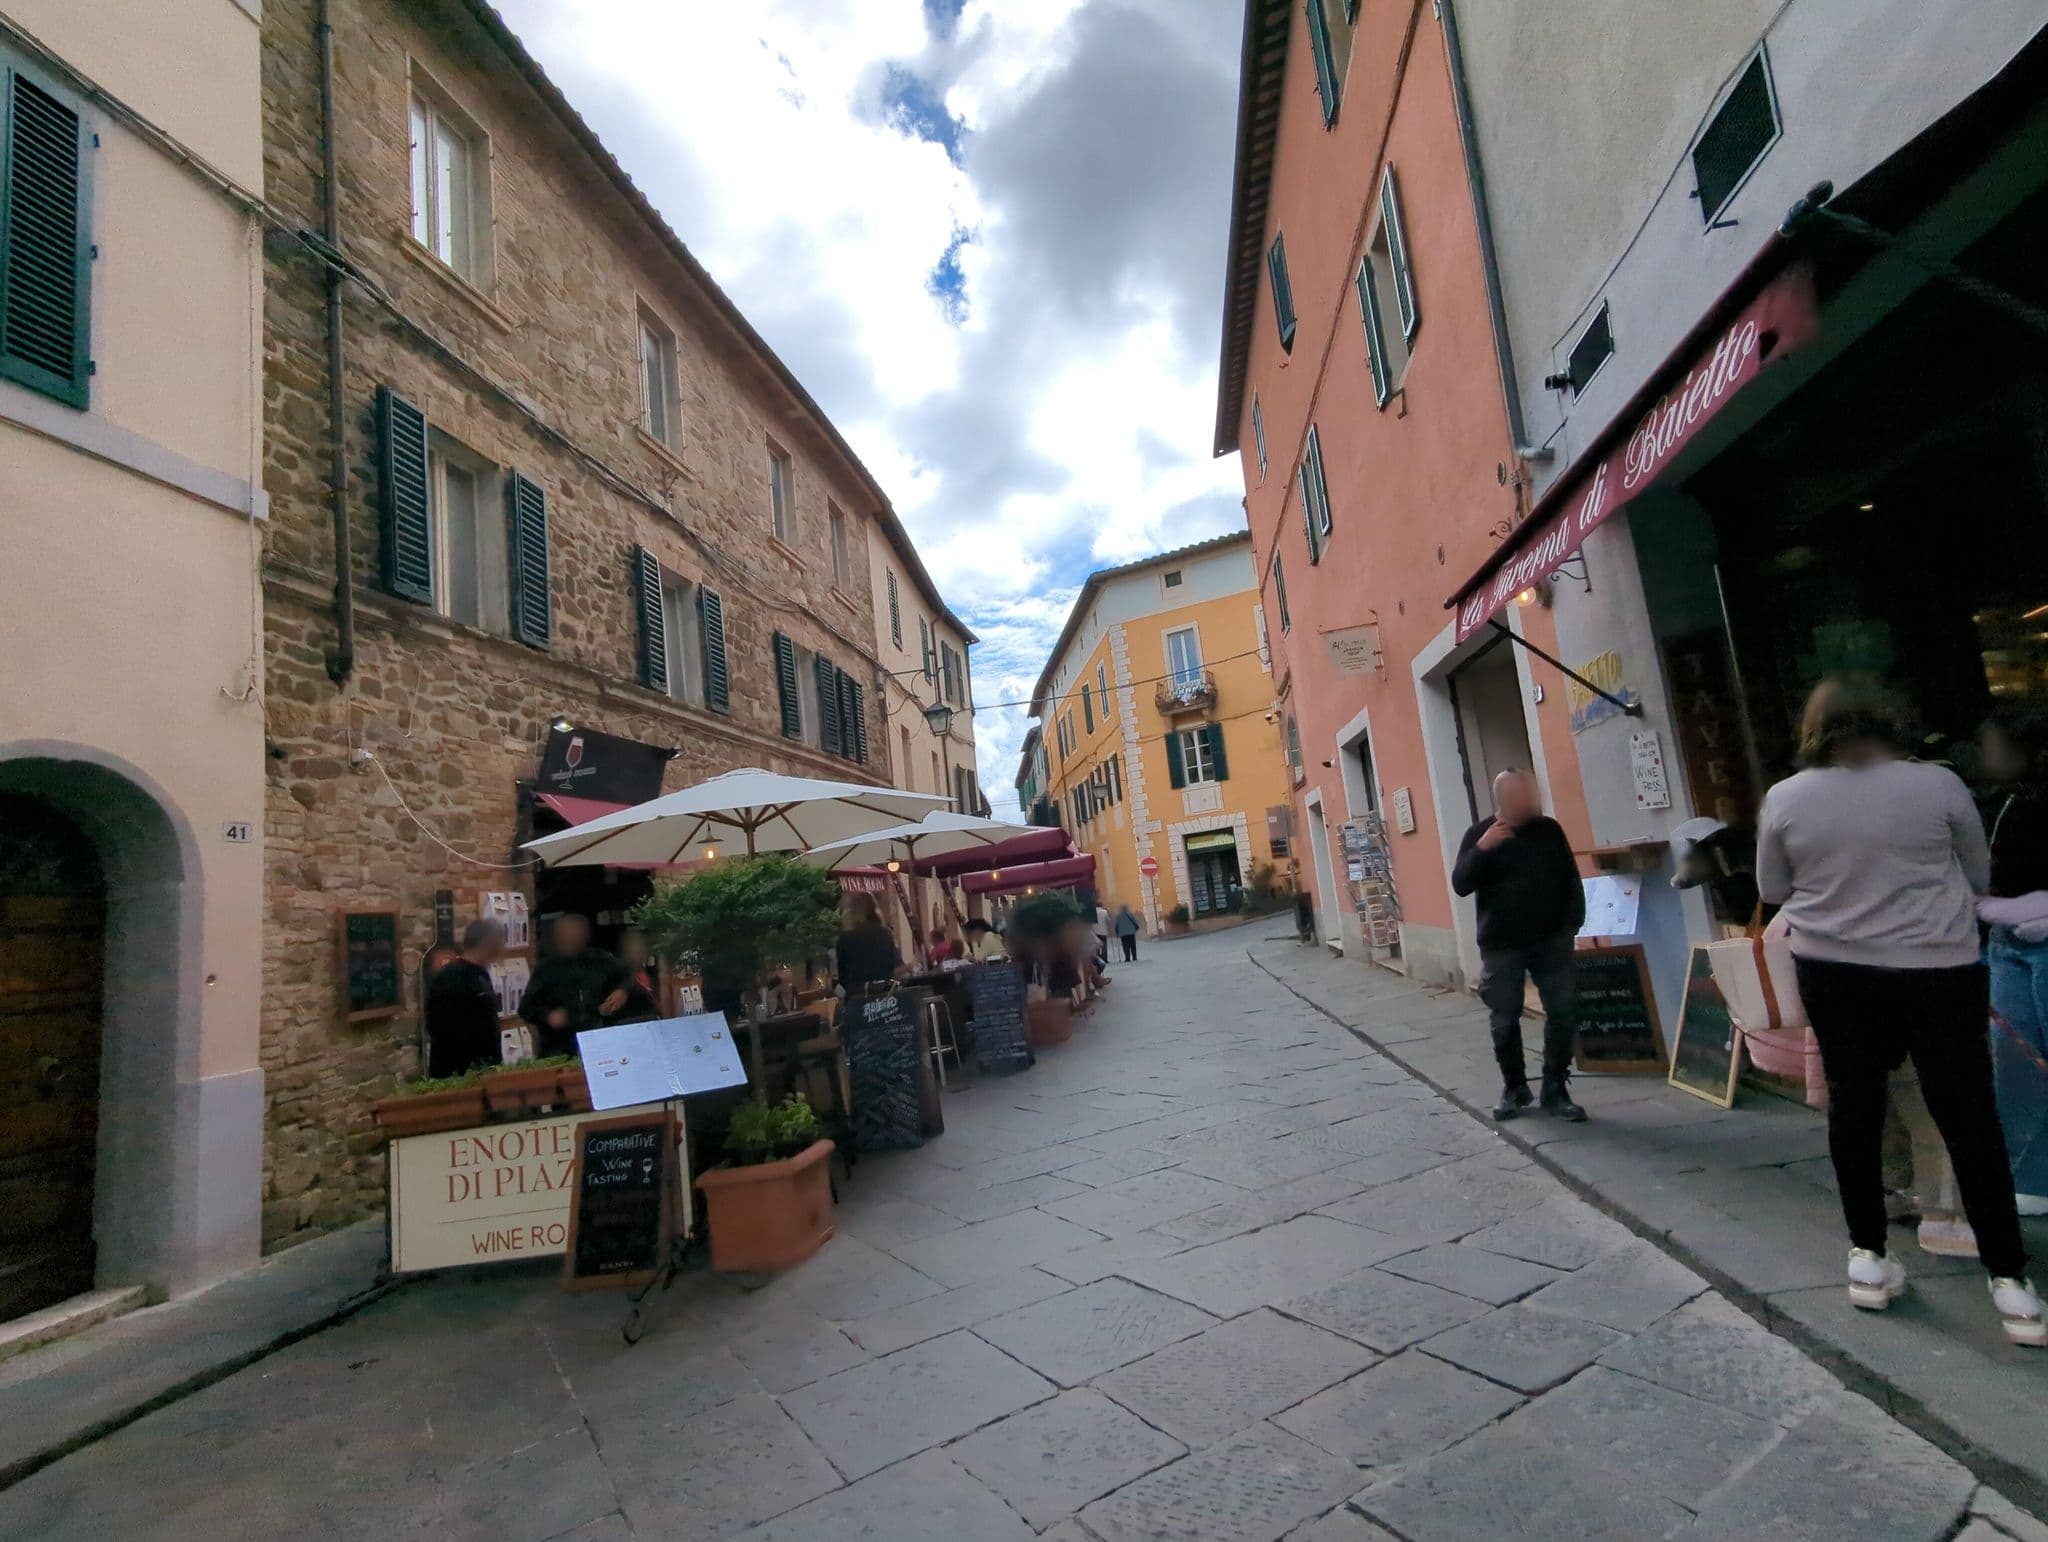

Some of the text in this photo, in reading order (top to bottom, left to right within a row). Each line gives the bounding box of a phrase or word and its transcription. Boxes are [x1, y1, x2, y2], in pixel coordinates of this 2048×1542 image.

[1461, 320, 1758, 632] La Taverna di Baietto
[227, 826, 246, 840] 41
[448, 1124, 577, 1169] ENOTE
[588, 1133, 657, 1154] COMPARATIVE
[602, 1156, 633, 1172] WINE
[448, 1170, 483, 1203] DI
[587, 1173, 628, 1185] TASTING
[472, 1227, 524, 1254] WINE
